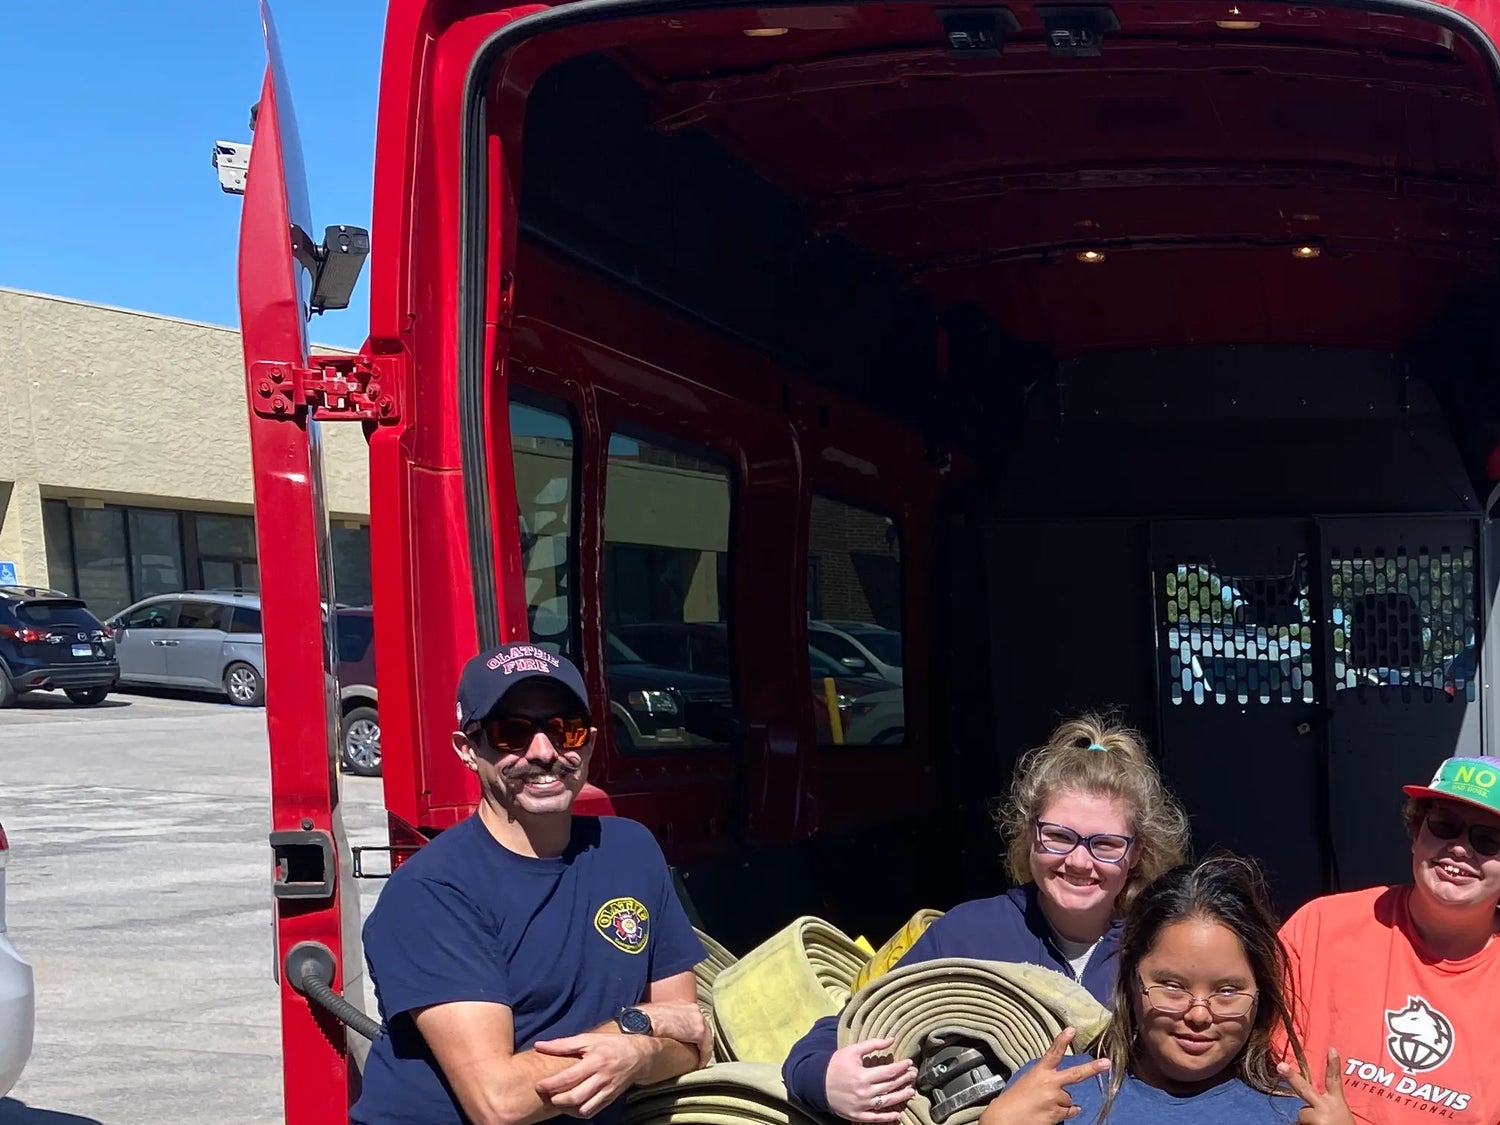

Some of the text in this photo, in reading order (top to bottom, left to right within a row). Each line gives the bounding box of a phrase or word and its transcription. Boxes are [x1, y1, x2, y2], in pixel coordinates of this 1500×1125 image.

[486, 645, 559, 669] OLATHE
[503, 658, 550, 674] FIRE
[1454, 765, 1497, 788] NO
[1344, 1058, 1472, 1111] TOM DAVIS
[1344, 1078, 1456, 1120] INTERNATIONAL
